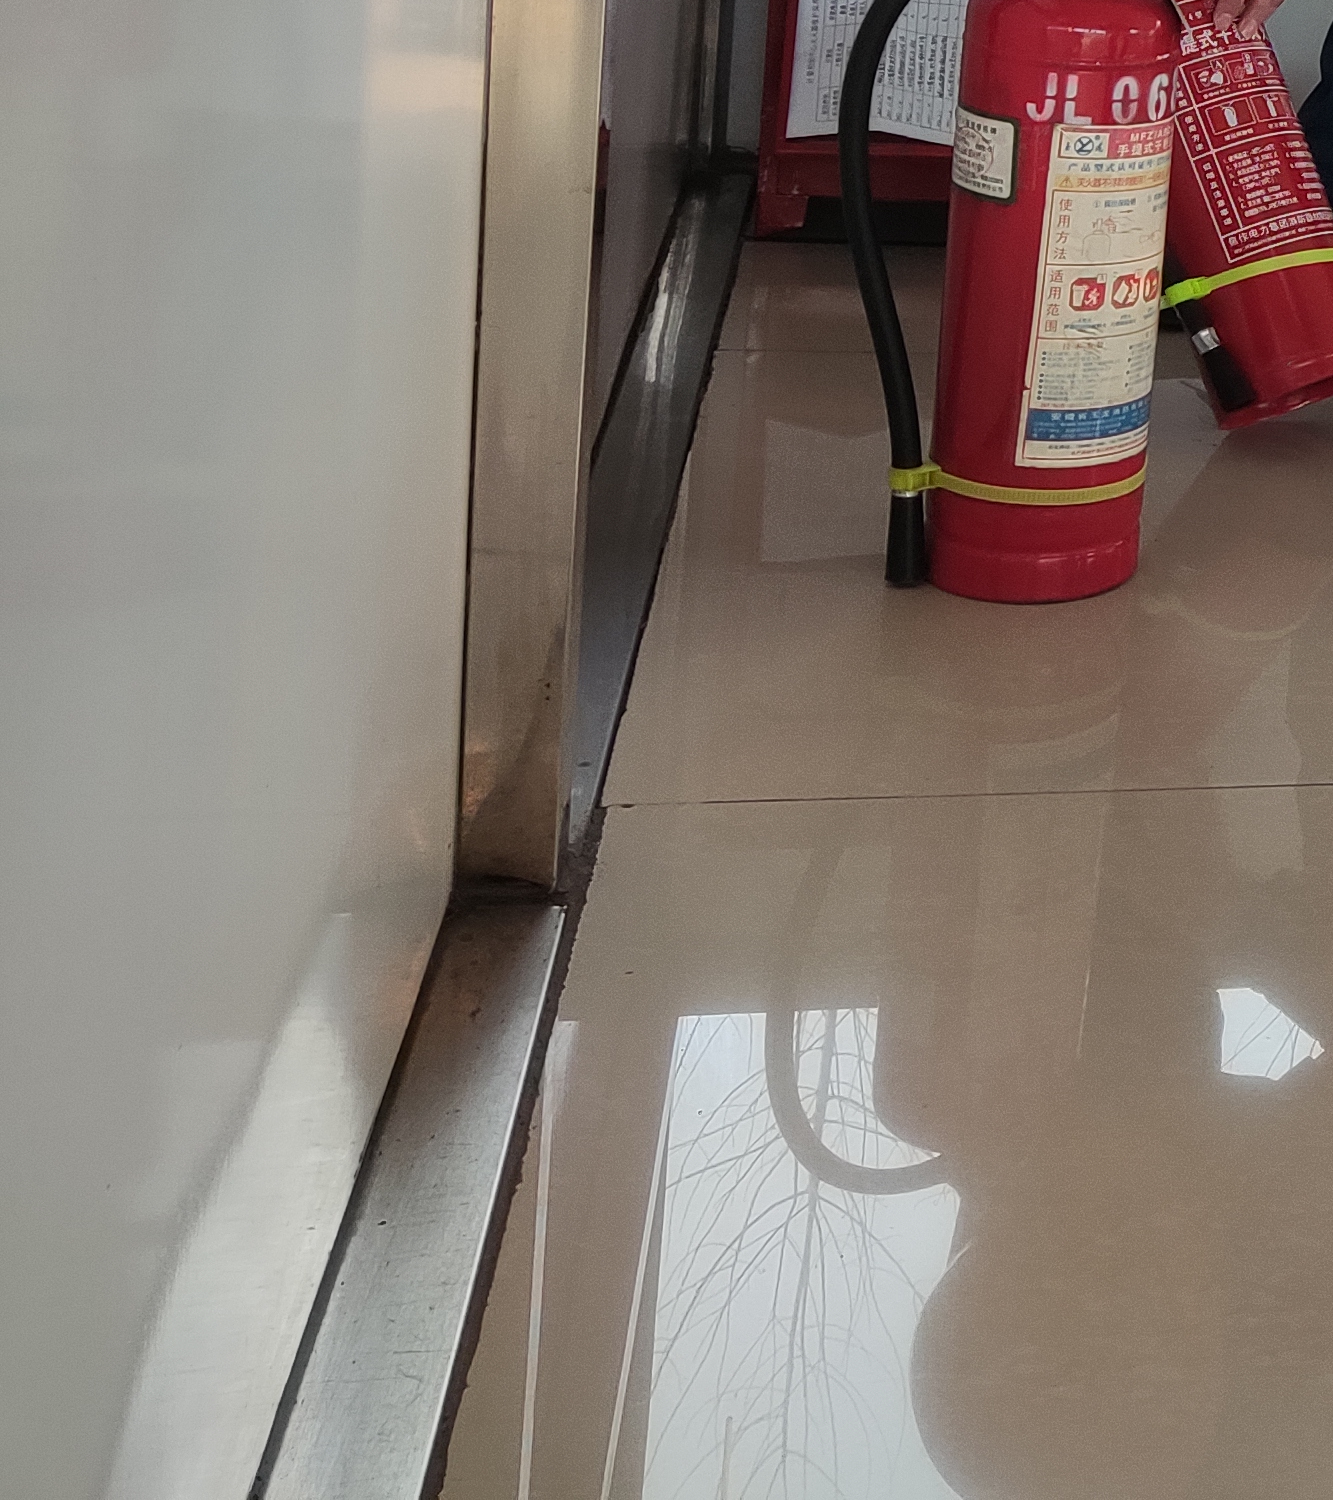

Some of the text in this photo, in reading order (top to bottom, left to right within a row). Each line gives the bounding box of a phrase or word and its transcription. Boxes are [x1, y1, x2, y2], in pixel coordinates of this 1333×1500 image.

[1026, 72, 1092, 125] JL
[1053, 198, 1073, 260] 使用方法
